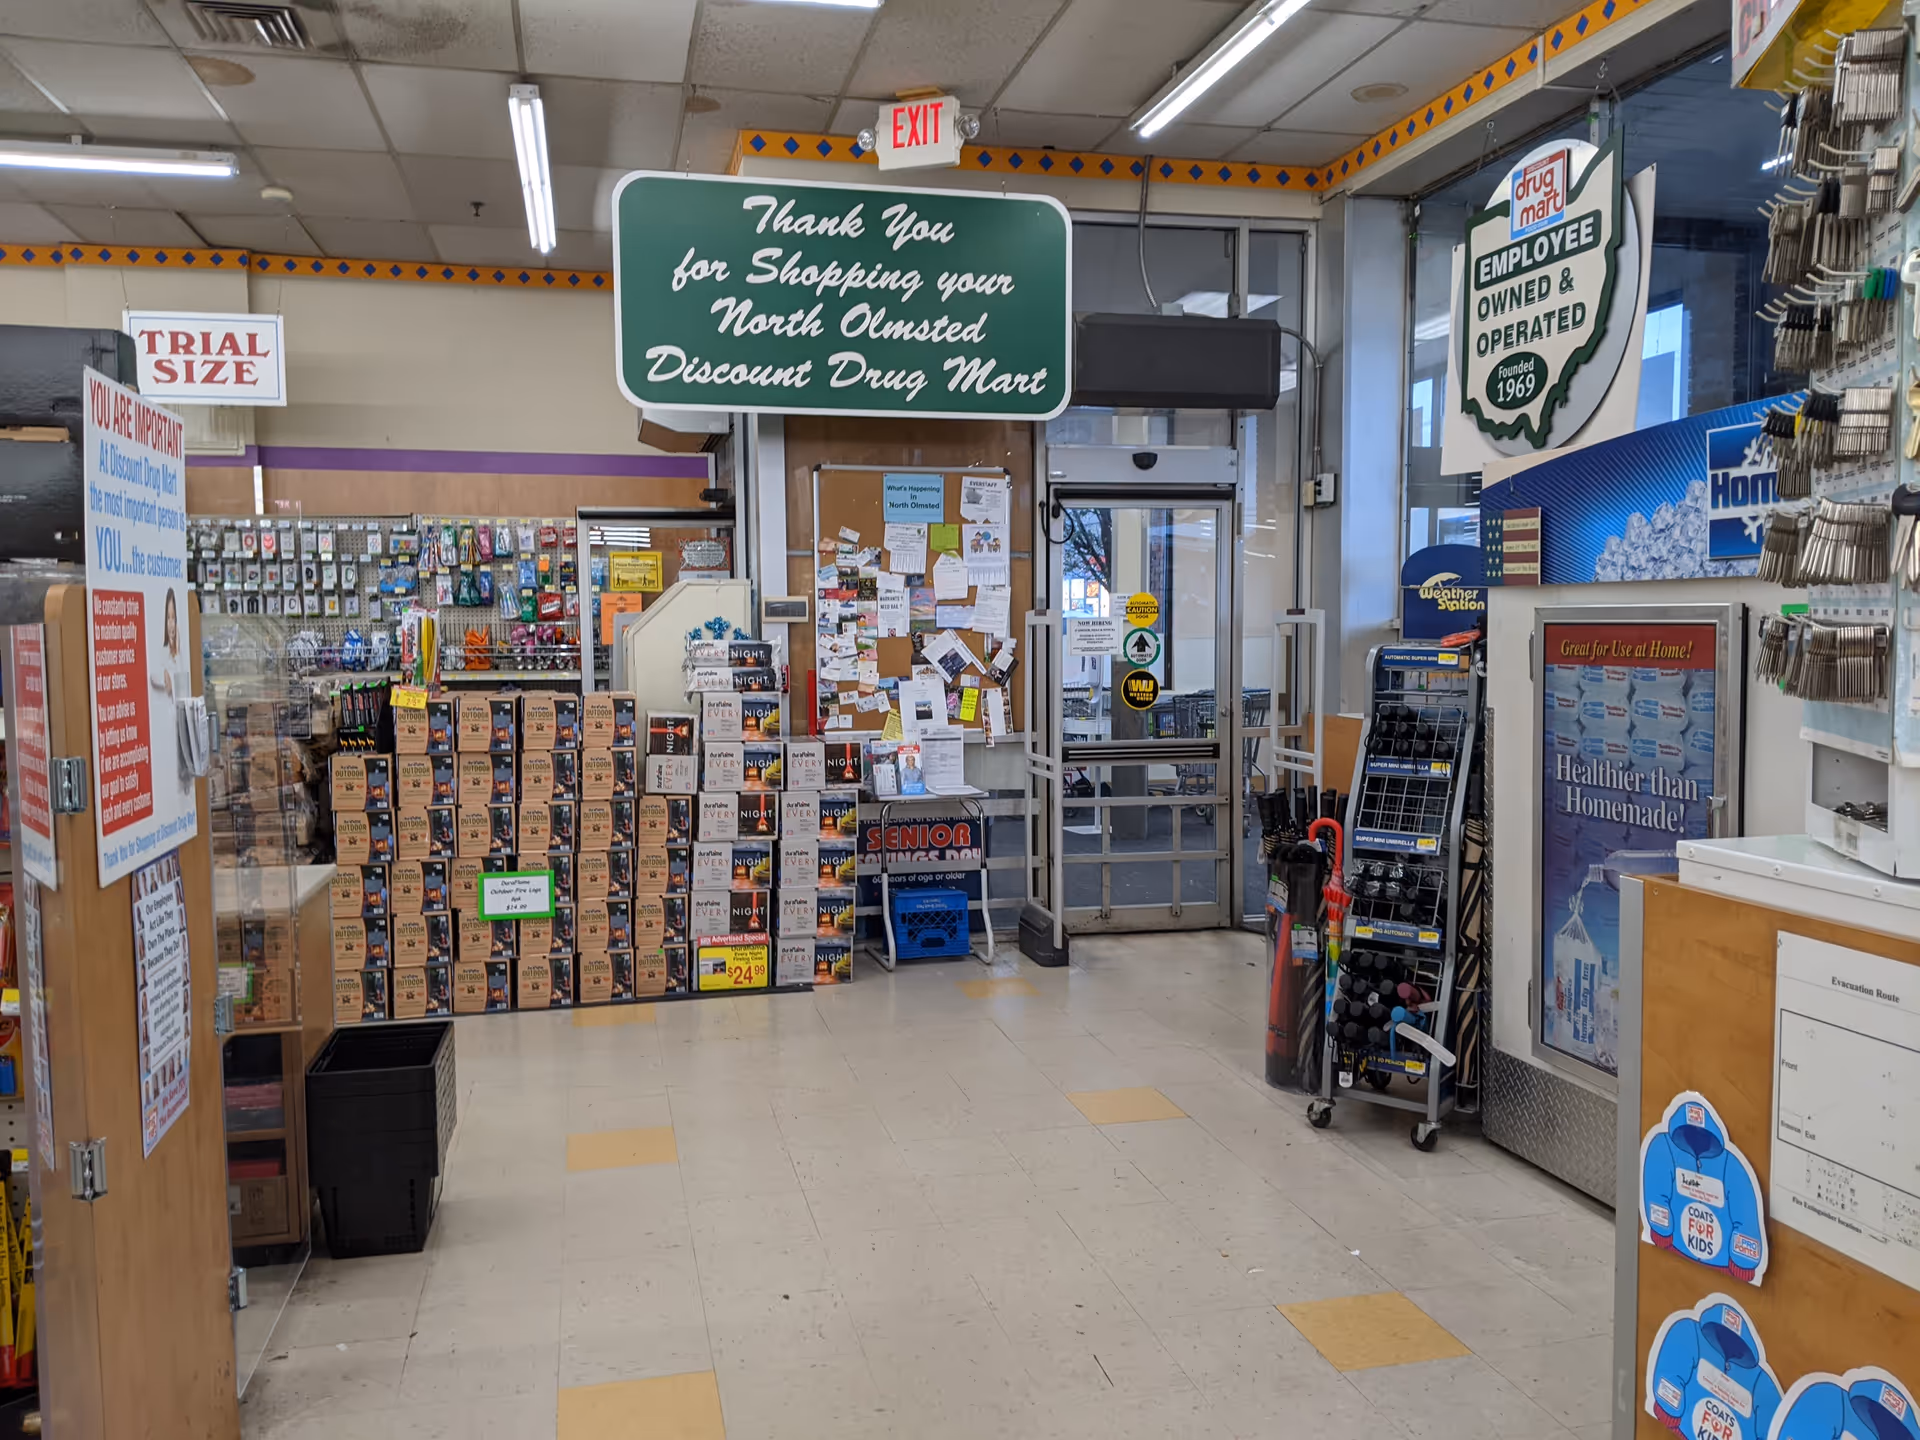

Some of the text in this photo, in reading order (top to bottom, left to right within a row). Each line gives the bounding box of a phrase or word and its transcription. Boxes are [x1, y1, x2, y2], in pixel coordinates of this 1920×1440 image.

[892, 102, 943, 149] EXIT
[1515, 167, 1554, 201] drug
[1520, 188, 1564, 227] mart
[742, 196, 954, 250] Thank You
[1479, 216, 1594, 284] EMPLOYEE
[671, 248, 1014, 304] for Shopping your
[1477, 267, 1574, 322] OWNED &
[710, 297, 988, 344] North Olmsted
[1476, 302, 1586, 358] OPERATED
[138, 330, 270, 358] TRIAL
[152, 358, 259, 386] SIZE
[645, 345, 1048, 402] Discount Drug Mart
[1498, 358, 1534, 379] Founded
[1496, 374, 1536, 403] 1969
[90, 377, 182, 460] YOU ARE IMPORTANT
[100, 439, 177, 498] At Discount Drug Mart
[908, 485, 940, 493] Happening
[90, 481, 185, 532] the most important person is
[147, 551, 183, 578] customer.
[1420, 588, 1479, 599] Weather
[1438, 599, 1485, 612] Station
[102, 597, 126, 619] constantly
[127, 597, 139, 616] strive
[101, 621, 121, 640] maintain
[1561, 639, 1693, 660] Great for Use at Home!
[1128, 680, 1154, 692] WU
[744, 708, 776, 717] NIGHT
[666, 720, 674, 753] NIGHT
[709, 760, 778, 768] EVERY NIGHT
[792, 758, 858, 768] EVERY NIGHT
[1557, 754, 1698, 801] Healthier than
[741, 810, 772, 818] NIGHT
[1566, 786, 1685, 834] Homemade!
[867, 822, 970, 850] SENIOR
[908, 873, 917, 882] of
[946, 872, 965, 880] older
[696, 906, 765, 916] EVERY NIGHT
[744, 934, 766, 942] Special
[1831, 975, 1900, 1004] Evacuation Route
[1781, 1058, 1798, 1073] Front
[1805, 1130, 1816, 1140] Exit
[1688, 1206, 1714, 1224] COATS
[1688, 1218, 1714, 1240] FOR
[1688, 1235, 1714, 1256] KIDS
[1705, 1400, 1735, 1428] COATS
